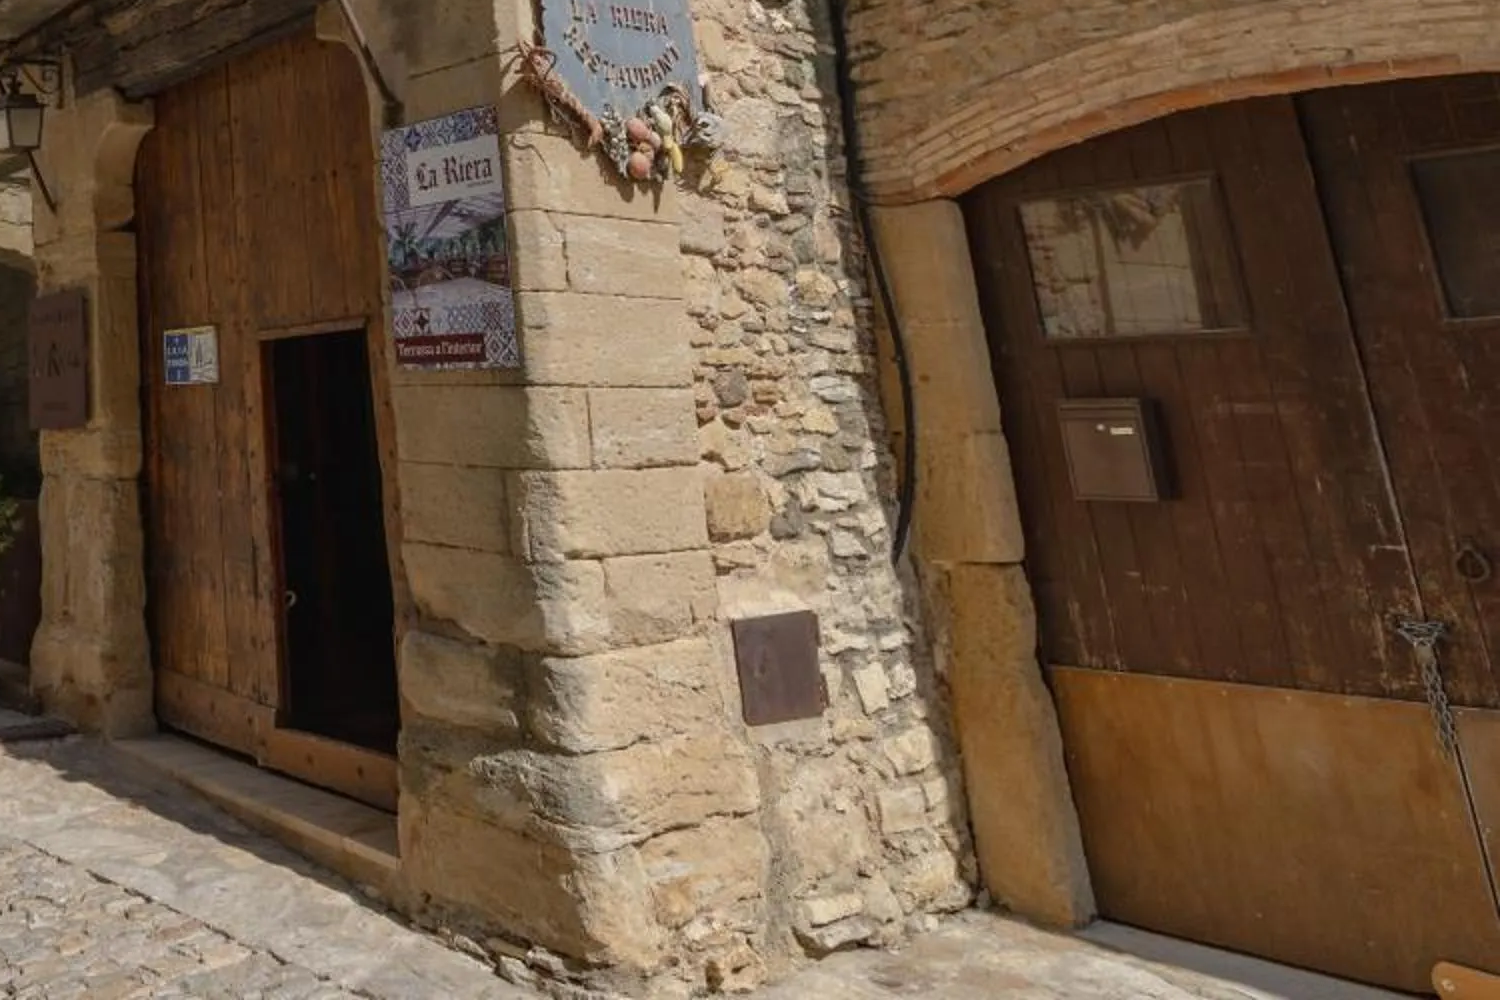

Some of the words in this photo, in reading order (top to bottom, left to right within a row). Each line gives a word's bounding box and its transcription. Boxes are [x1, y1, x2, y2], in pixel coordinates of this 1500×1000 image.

[610, 3, 669, 36] RIERA
[562, 25, 680, 90] RESTAURANT
[416, 162, 439, 191] La
[442, 155, 493, 185] Riera
